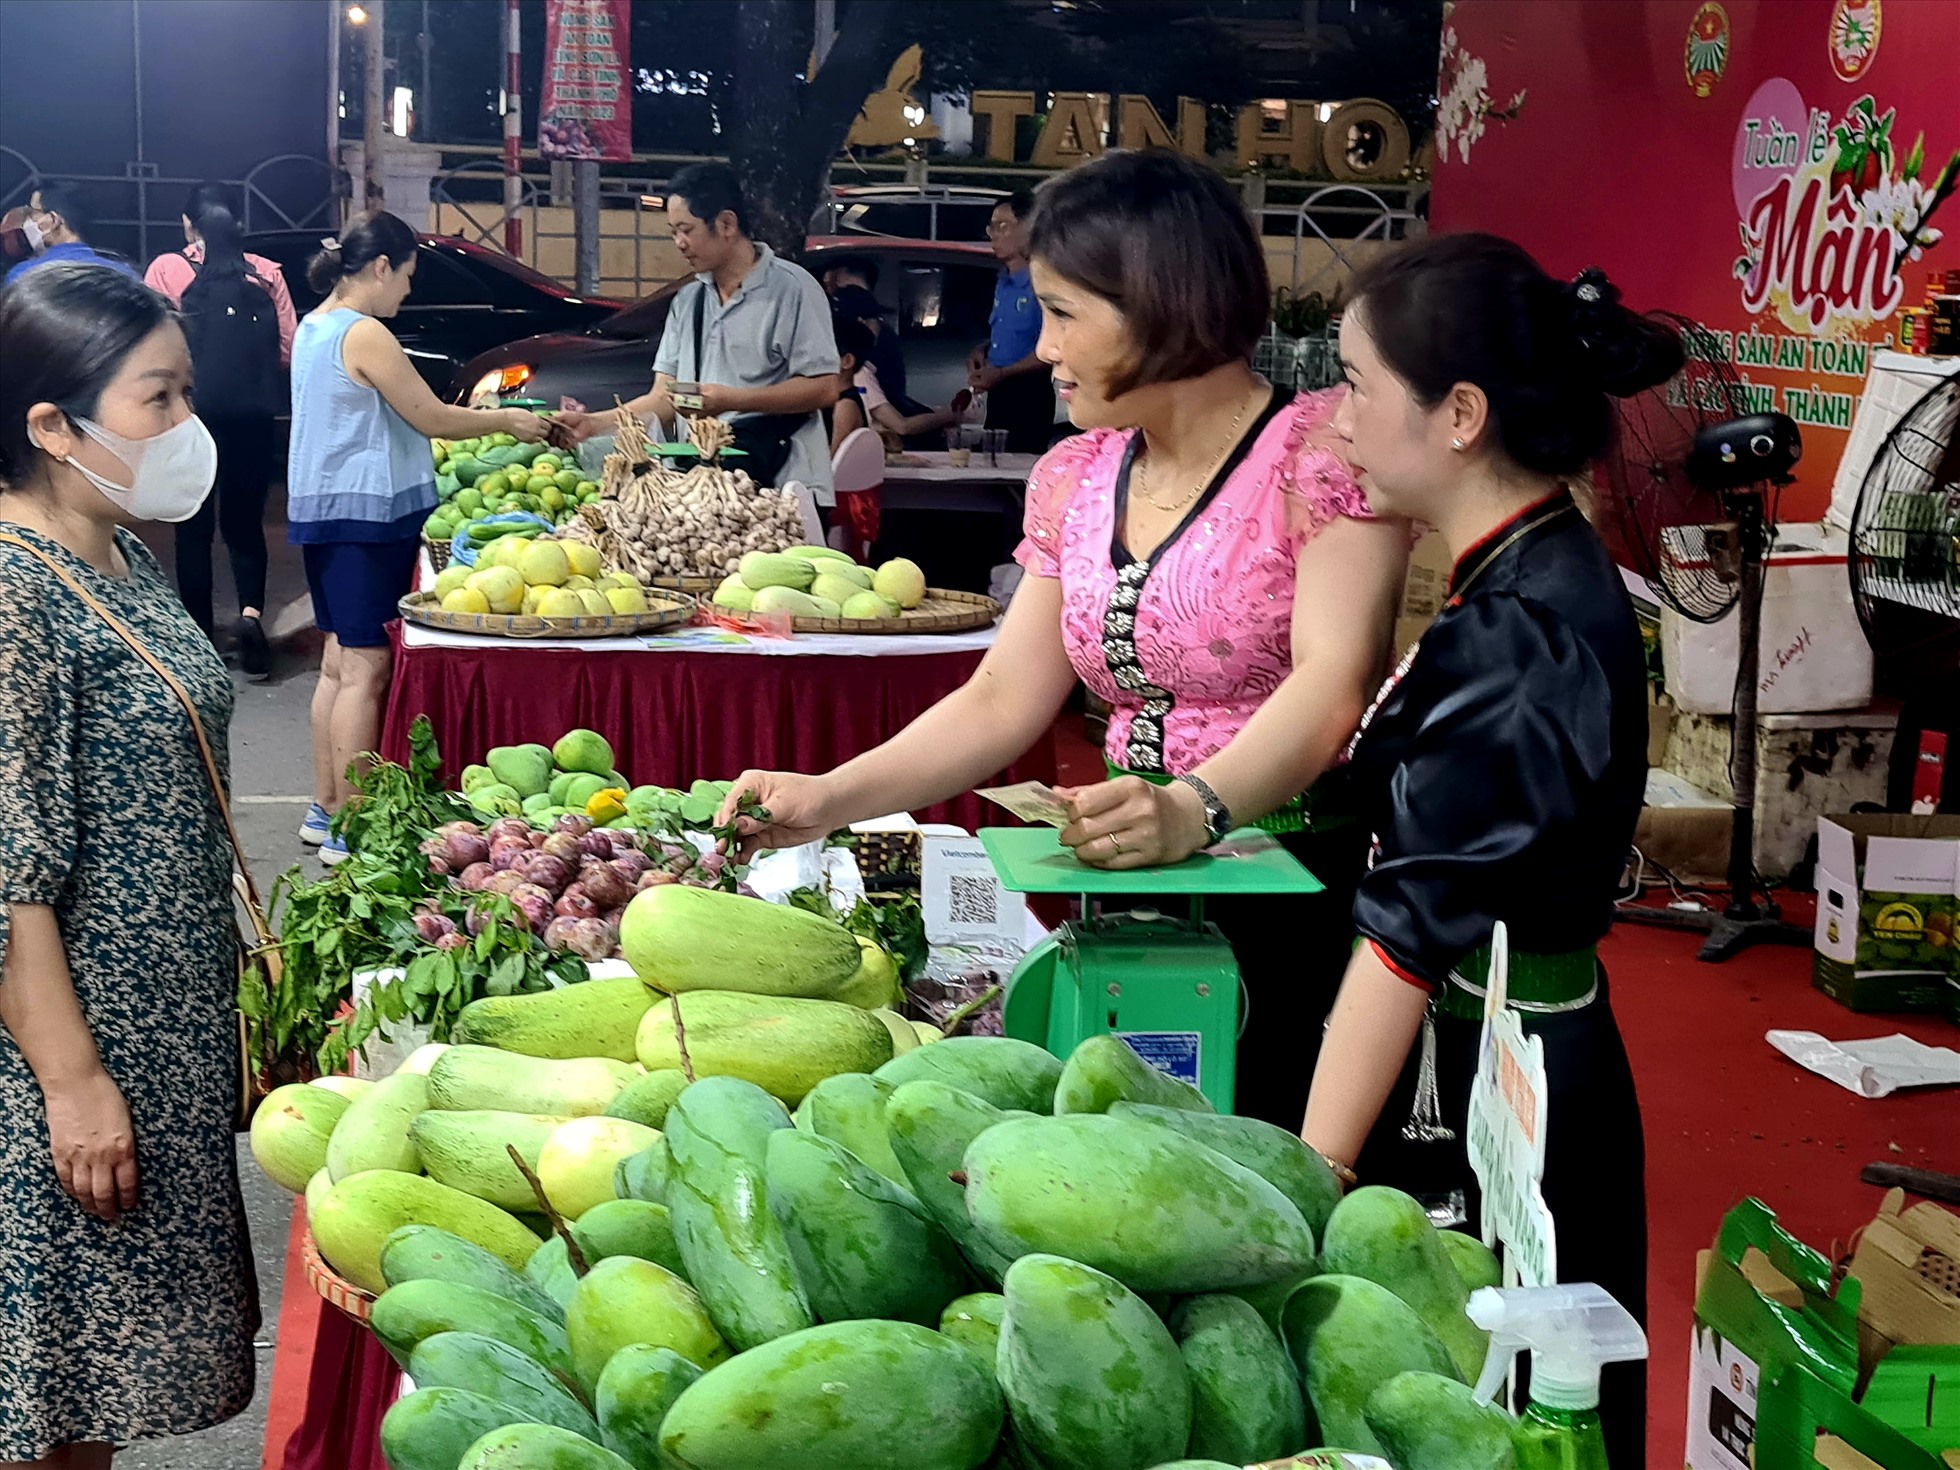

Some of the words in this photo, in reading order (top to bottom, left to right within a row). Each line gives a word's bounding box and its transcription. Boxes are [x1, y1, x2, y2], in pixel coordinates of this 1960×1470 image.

[1744, 115, 1799, 168] Tuần
[1805, 107, 1831, 164] lễ
[1743, 175, 1902, 330] Mận
[1736, 324, 1774, 368] SẢN
[1777, 335, 1807, 371] AN
[1811, 334, 1867, 377] TOÀN
[1783, 383, 1852, 429] THÀNH
